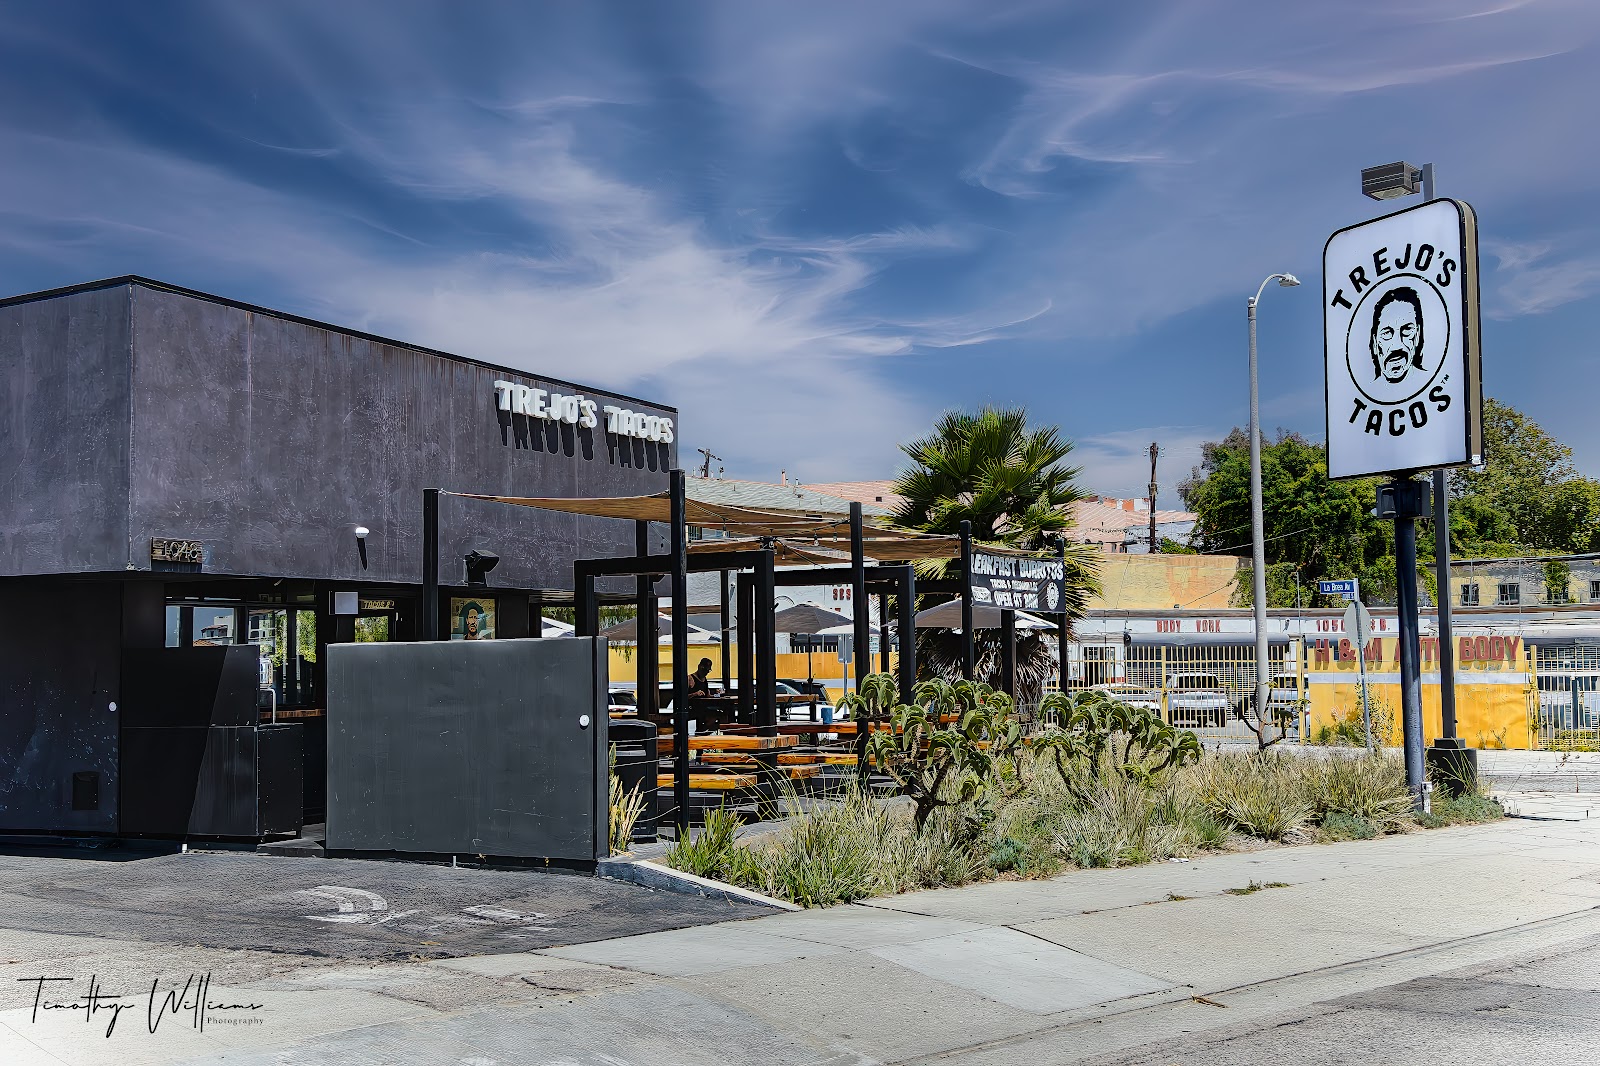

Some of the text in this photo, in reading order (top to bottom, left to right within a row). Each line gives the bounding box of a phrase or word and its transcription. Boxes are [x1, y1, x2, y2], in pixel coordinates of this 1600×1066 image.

[1331, 243, 1456, 311] TREJO'S
[494, 380, 674, 444] TREJO'S TACOS
[1349, 385, 1451, 437] TACOS
[163, 541, 198, 559] 1048
[970, 553, 1064, 581] EAKFAST BURRITOS
[993, 590, 1013, 608] OPEN
[1013, 592, 1023, 609] AT
[1323, 583, 1331, 591] La
[1331, 582, 1343, 591] Brea
[1156, 619, 1221, 633] BODY WORK
[1314, 638, 1330, 662] H
[1339, 638, 1357, 662] &
[1459, 635, 1521, 662] BODY
